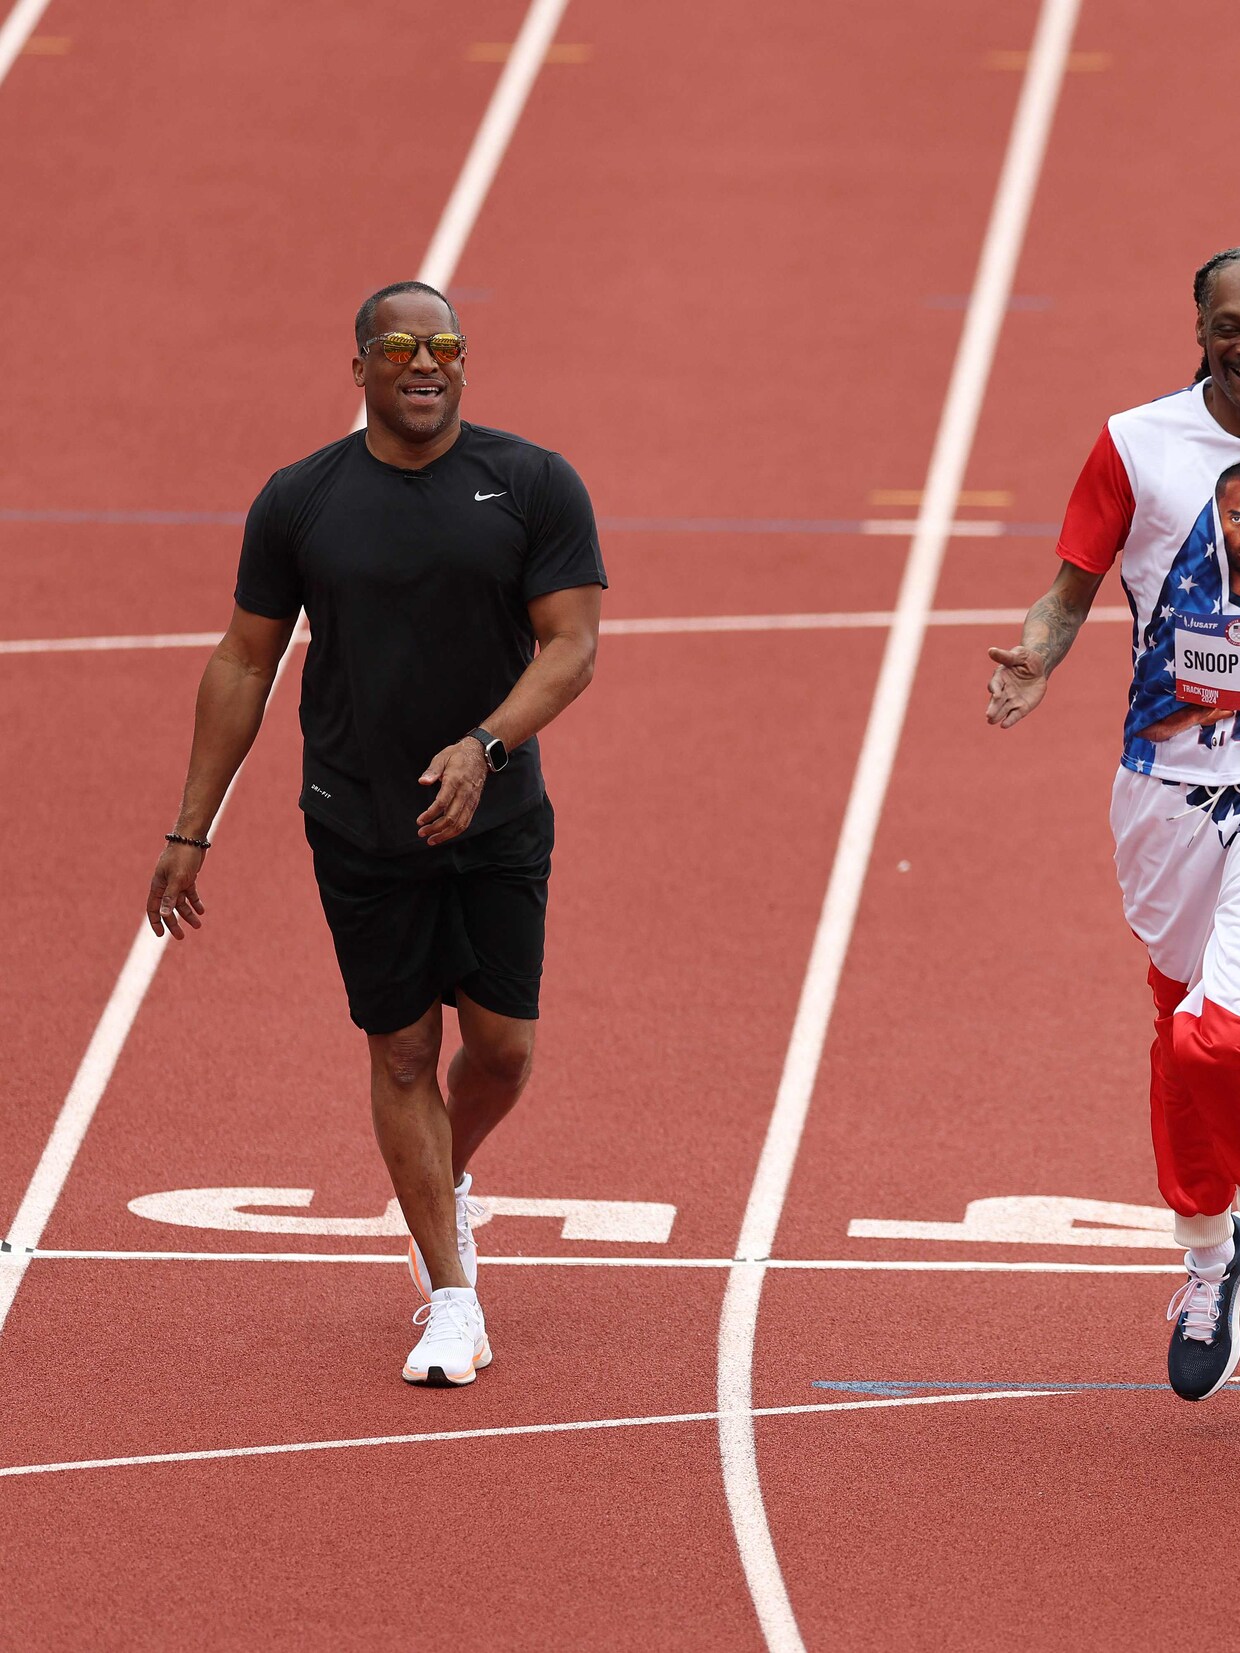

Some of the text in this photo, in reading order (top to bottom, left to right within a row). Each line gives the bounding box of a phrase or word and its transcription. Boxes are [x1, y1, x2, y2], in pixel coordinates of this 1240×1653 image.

[1193, 621, 1219, 629] USATF
[1184, 649, 1239, 674] SNOOP
[1201, 695, 1217, 704] 2024
[311, 783, 332, 799] DRI-FIT
[127, 1187, 676, 1244] 5
